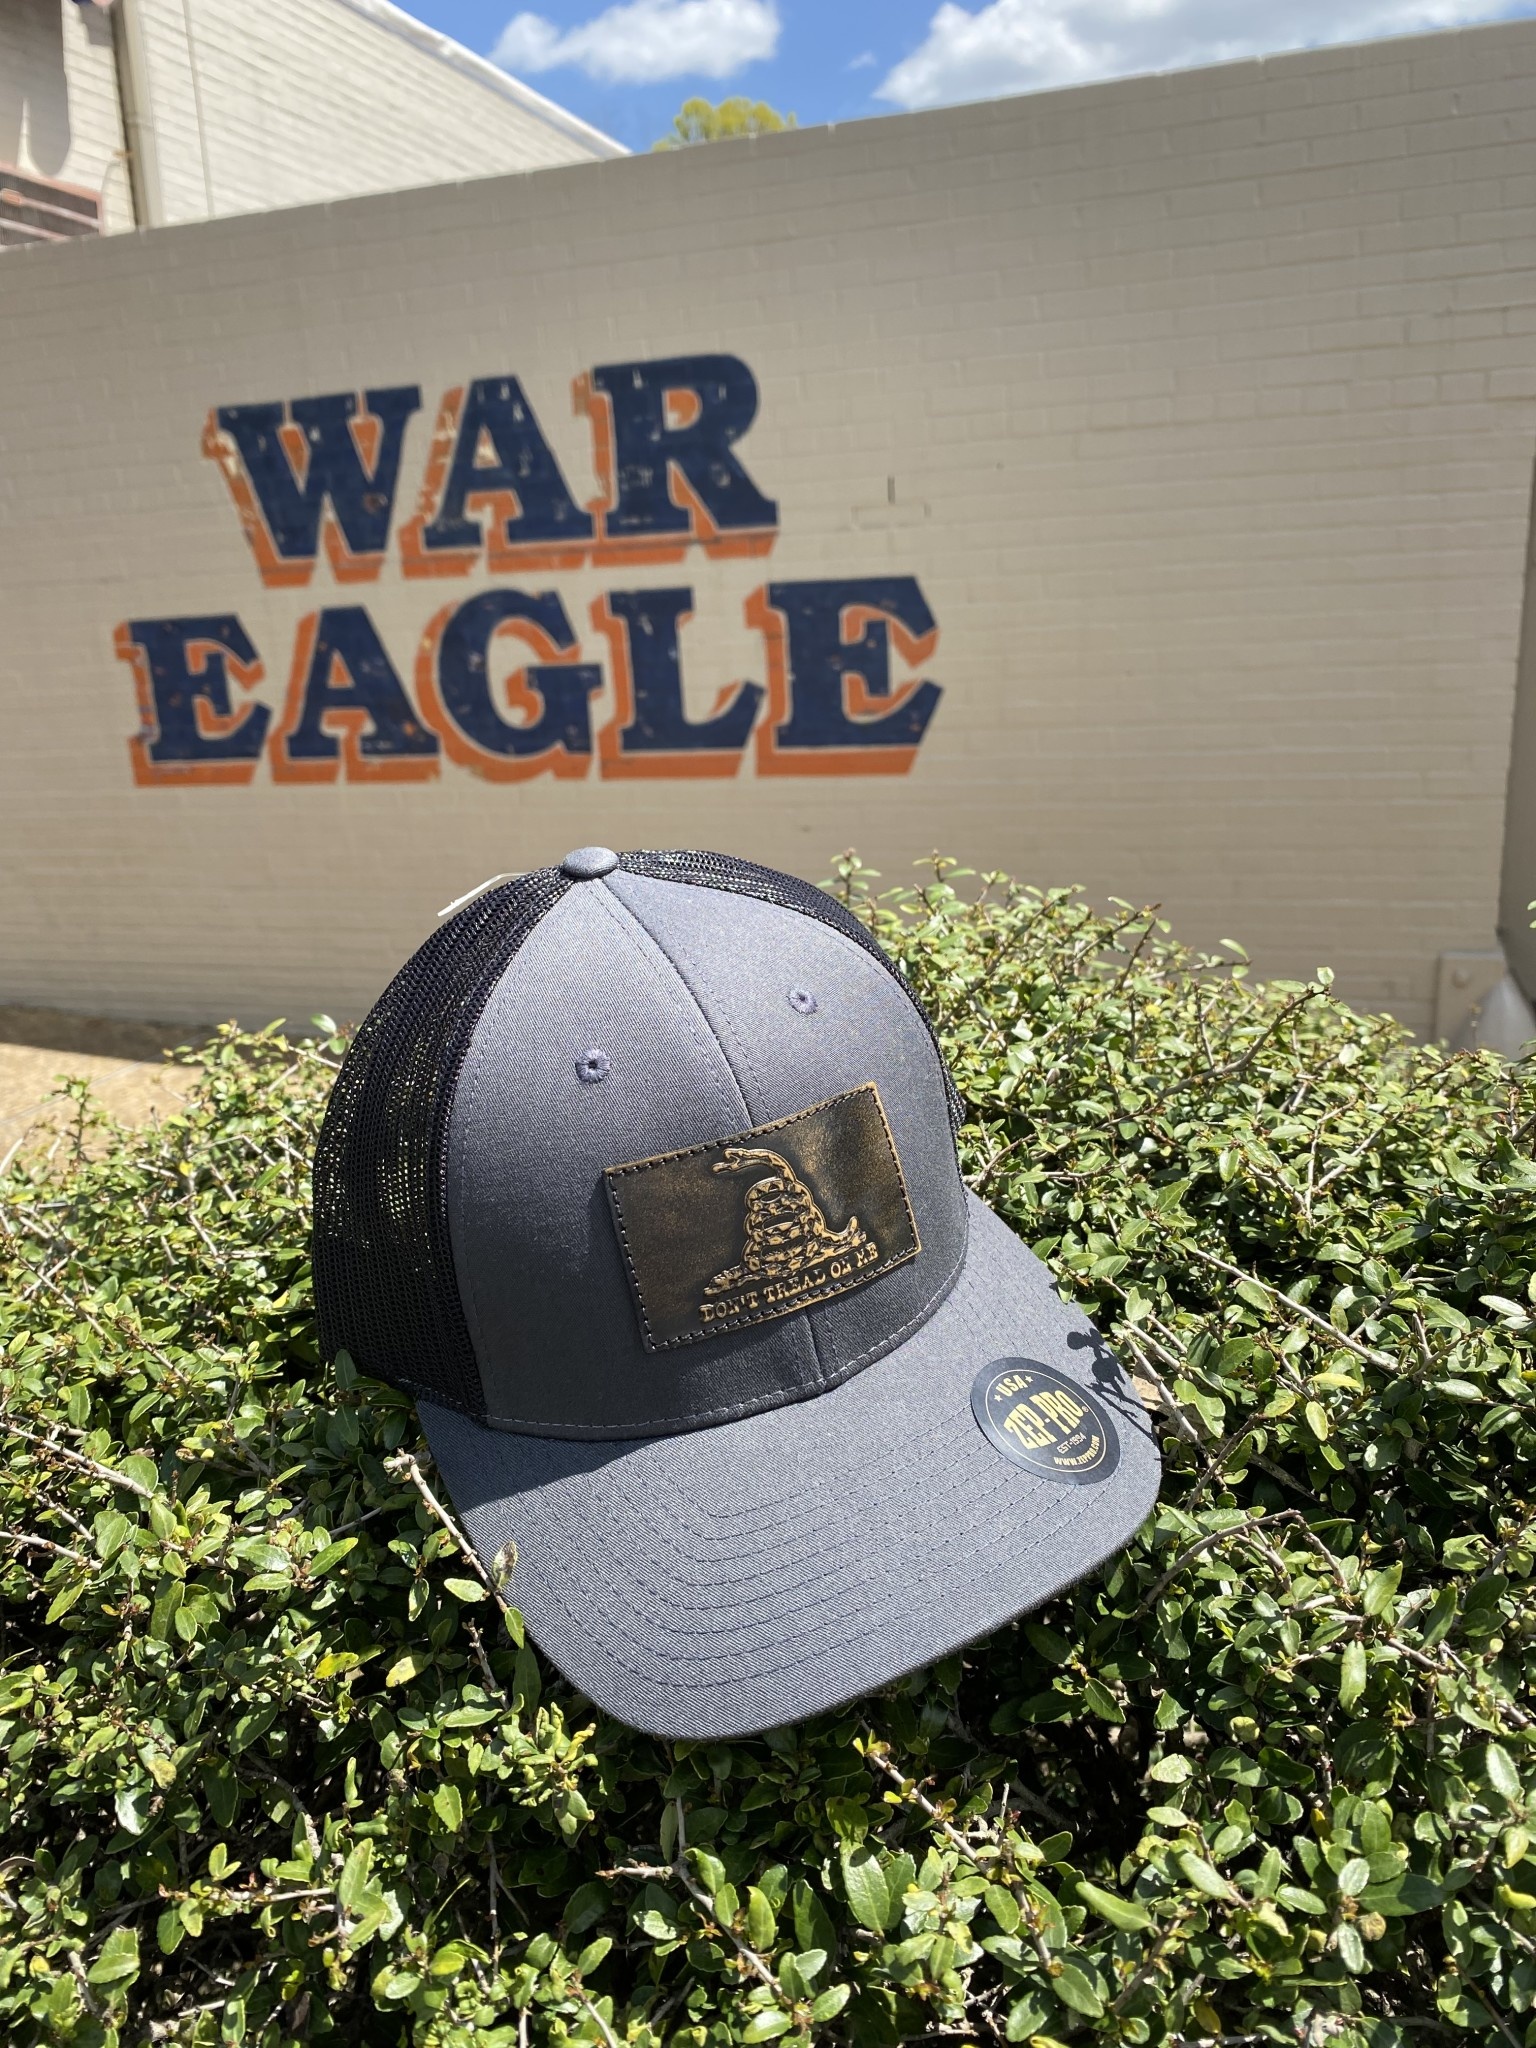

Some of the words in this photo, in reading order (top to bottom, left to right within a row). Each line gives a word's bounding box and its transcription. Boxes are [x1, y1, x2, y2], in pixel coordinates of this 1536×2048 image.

[203, 354, 779, 588] WAR
[114, 576, 943, 786] EAGLE
[700, 1291, 758, 1322] DON'T
[763, 1268, 826, 1303] TREAD
[830, 1256, 852, 1279] ON
[855, 1242, 879, 1268] ME
[996, 1375, 1028, 1397] USA
